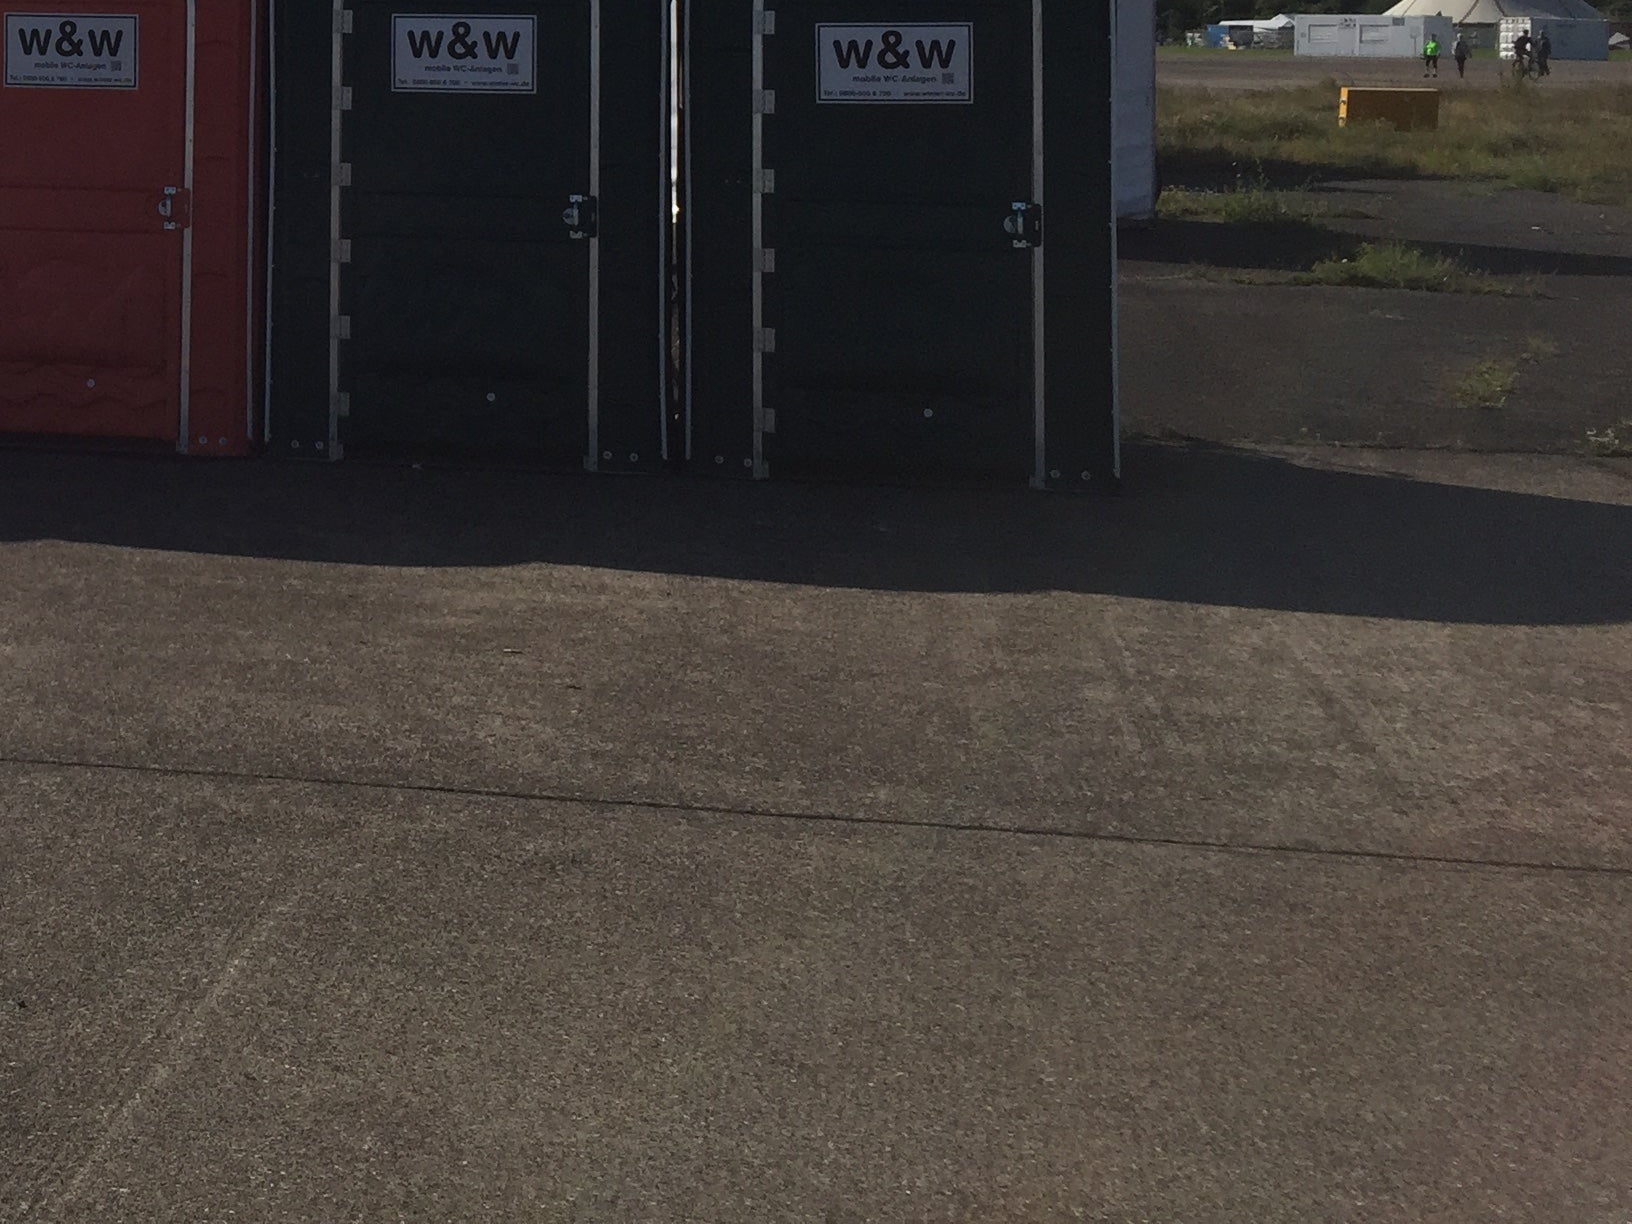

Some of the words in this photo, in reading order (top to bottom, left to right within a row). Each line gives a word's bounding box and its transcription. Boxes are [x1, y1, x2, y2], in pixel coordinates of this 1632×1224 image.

[18, 20, 124, 57] W&W
[407, 21, 520, 60] W&W
[832, 30, 956, 70] W&W
[424, 63, 451, 72] mobile
[852, 74, 881, 83] mobile
